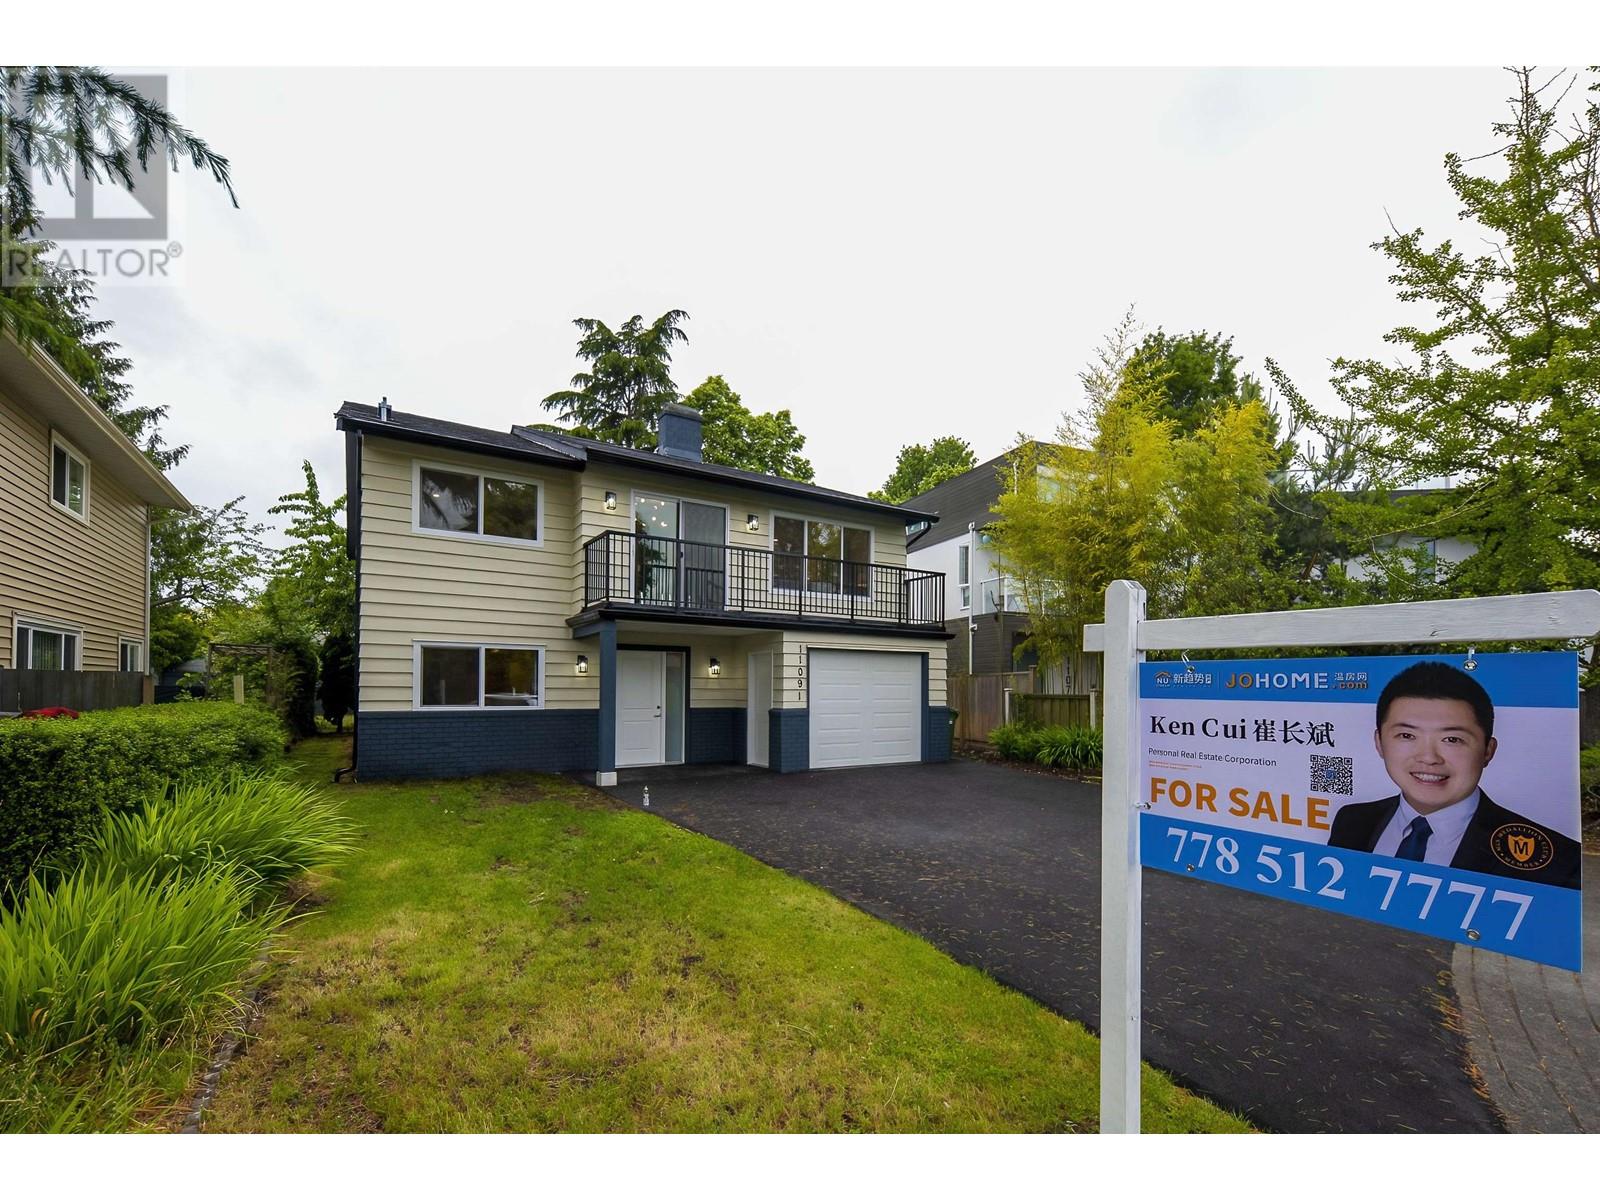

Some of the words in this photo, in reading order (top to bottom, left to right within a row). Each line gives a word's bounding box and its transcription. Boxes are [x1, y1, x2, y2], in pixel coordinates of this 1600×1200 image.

[1225, 672, 1328, 689] JOHOME
[1150, 715, 1195, 736] Ken
[1201, 718, 1247, 739] Cui
[1253, 719, 1335, 747] 崔长斌
[1148, 747, 1179, 757] Personal
[1181, 750, 1197, 759] Real
[1199, 752, 1223, 762] Estate
[1225, 754, 1277, 767] Corporation
[1151, 777, 1218, 813] FOR
[1228, 787, 1330, 831] SALE
[1166, 827, 1240, 875] 778
[1256, 844, 1347, 900] 512
[1369, 865, 1534, 941] 7777
